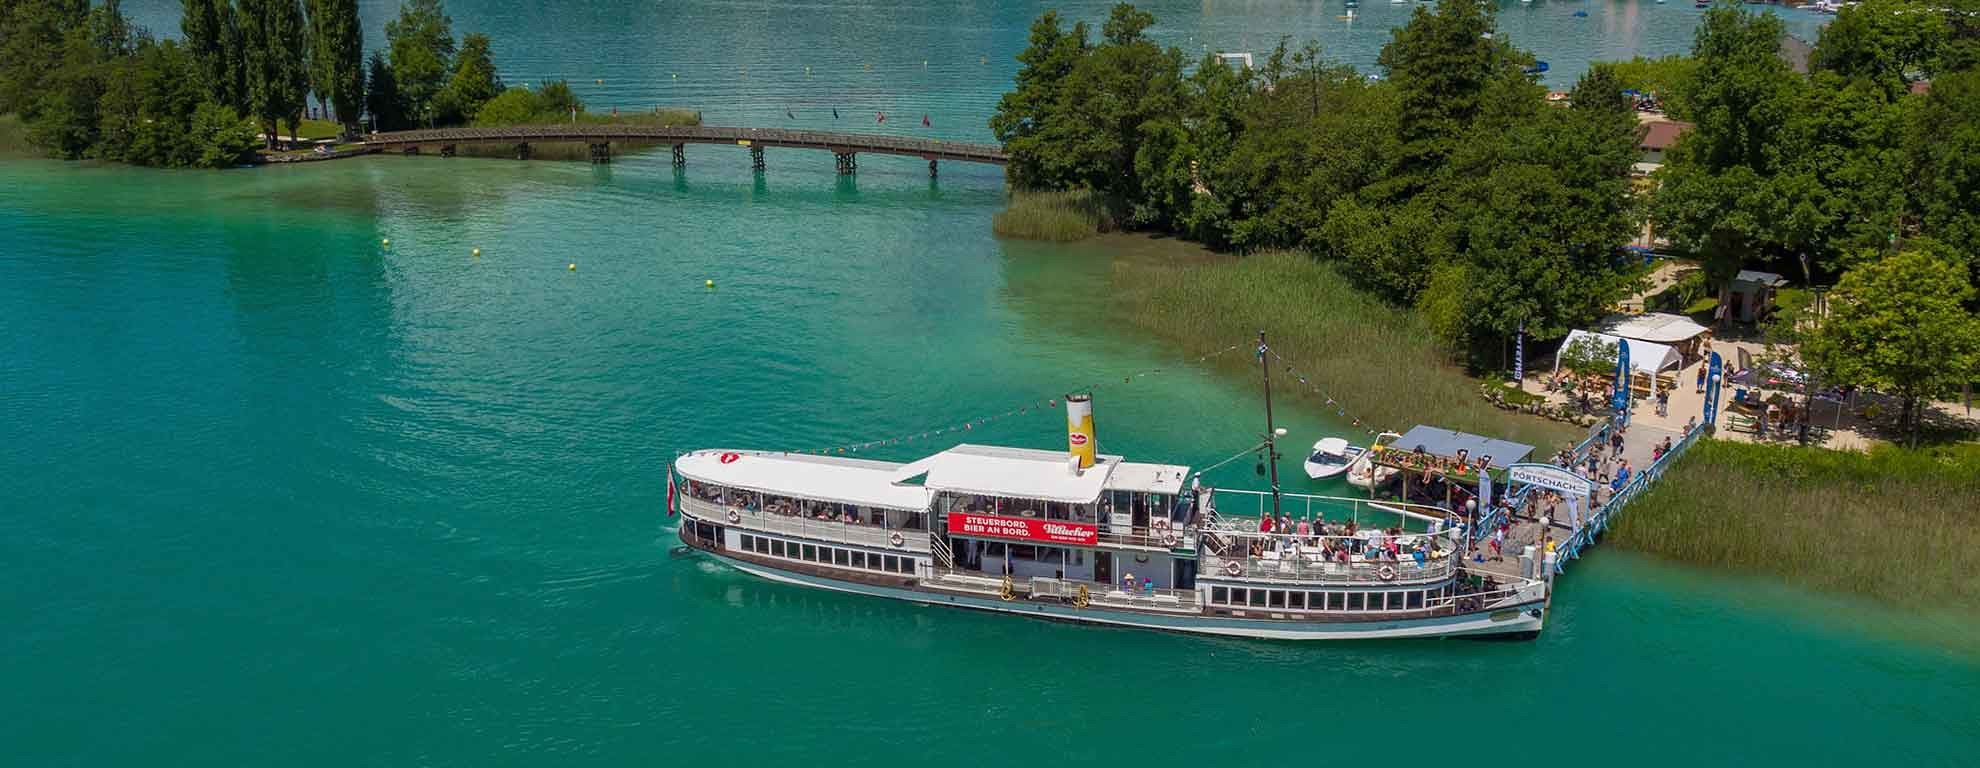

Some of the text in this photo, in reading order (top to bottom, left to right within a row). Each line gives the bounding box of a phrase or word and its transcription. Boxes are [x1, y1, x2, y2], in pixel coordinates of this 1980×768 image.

[1513, 471, 1576, 491] PÖRTSCHACH
[966, 516, 1029, 529] STEUERBORD.
[964, 525, 1031, 537] BIER AN BORD.
